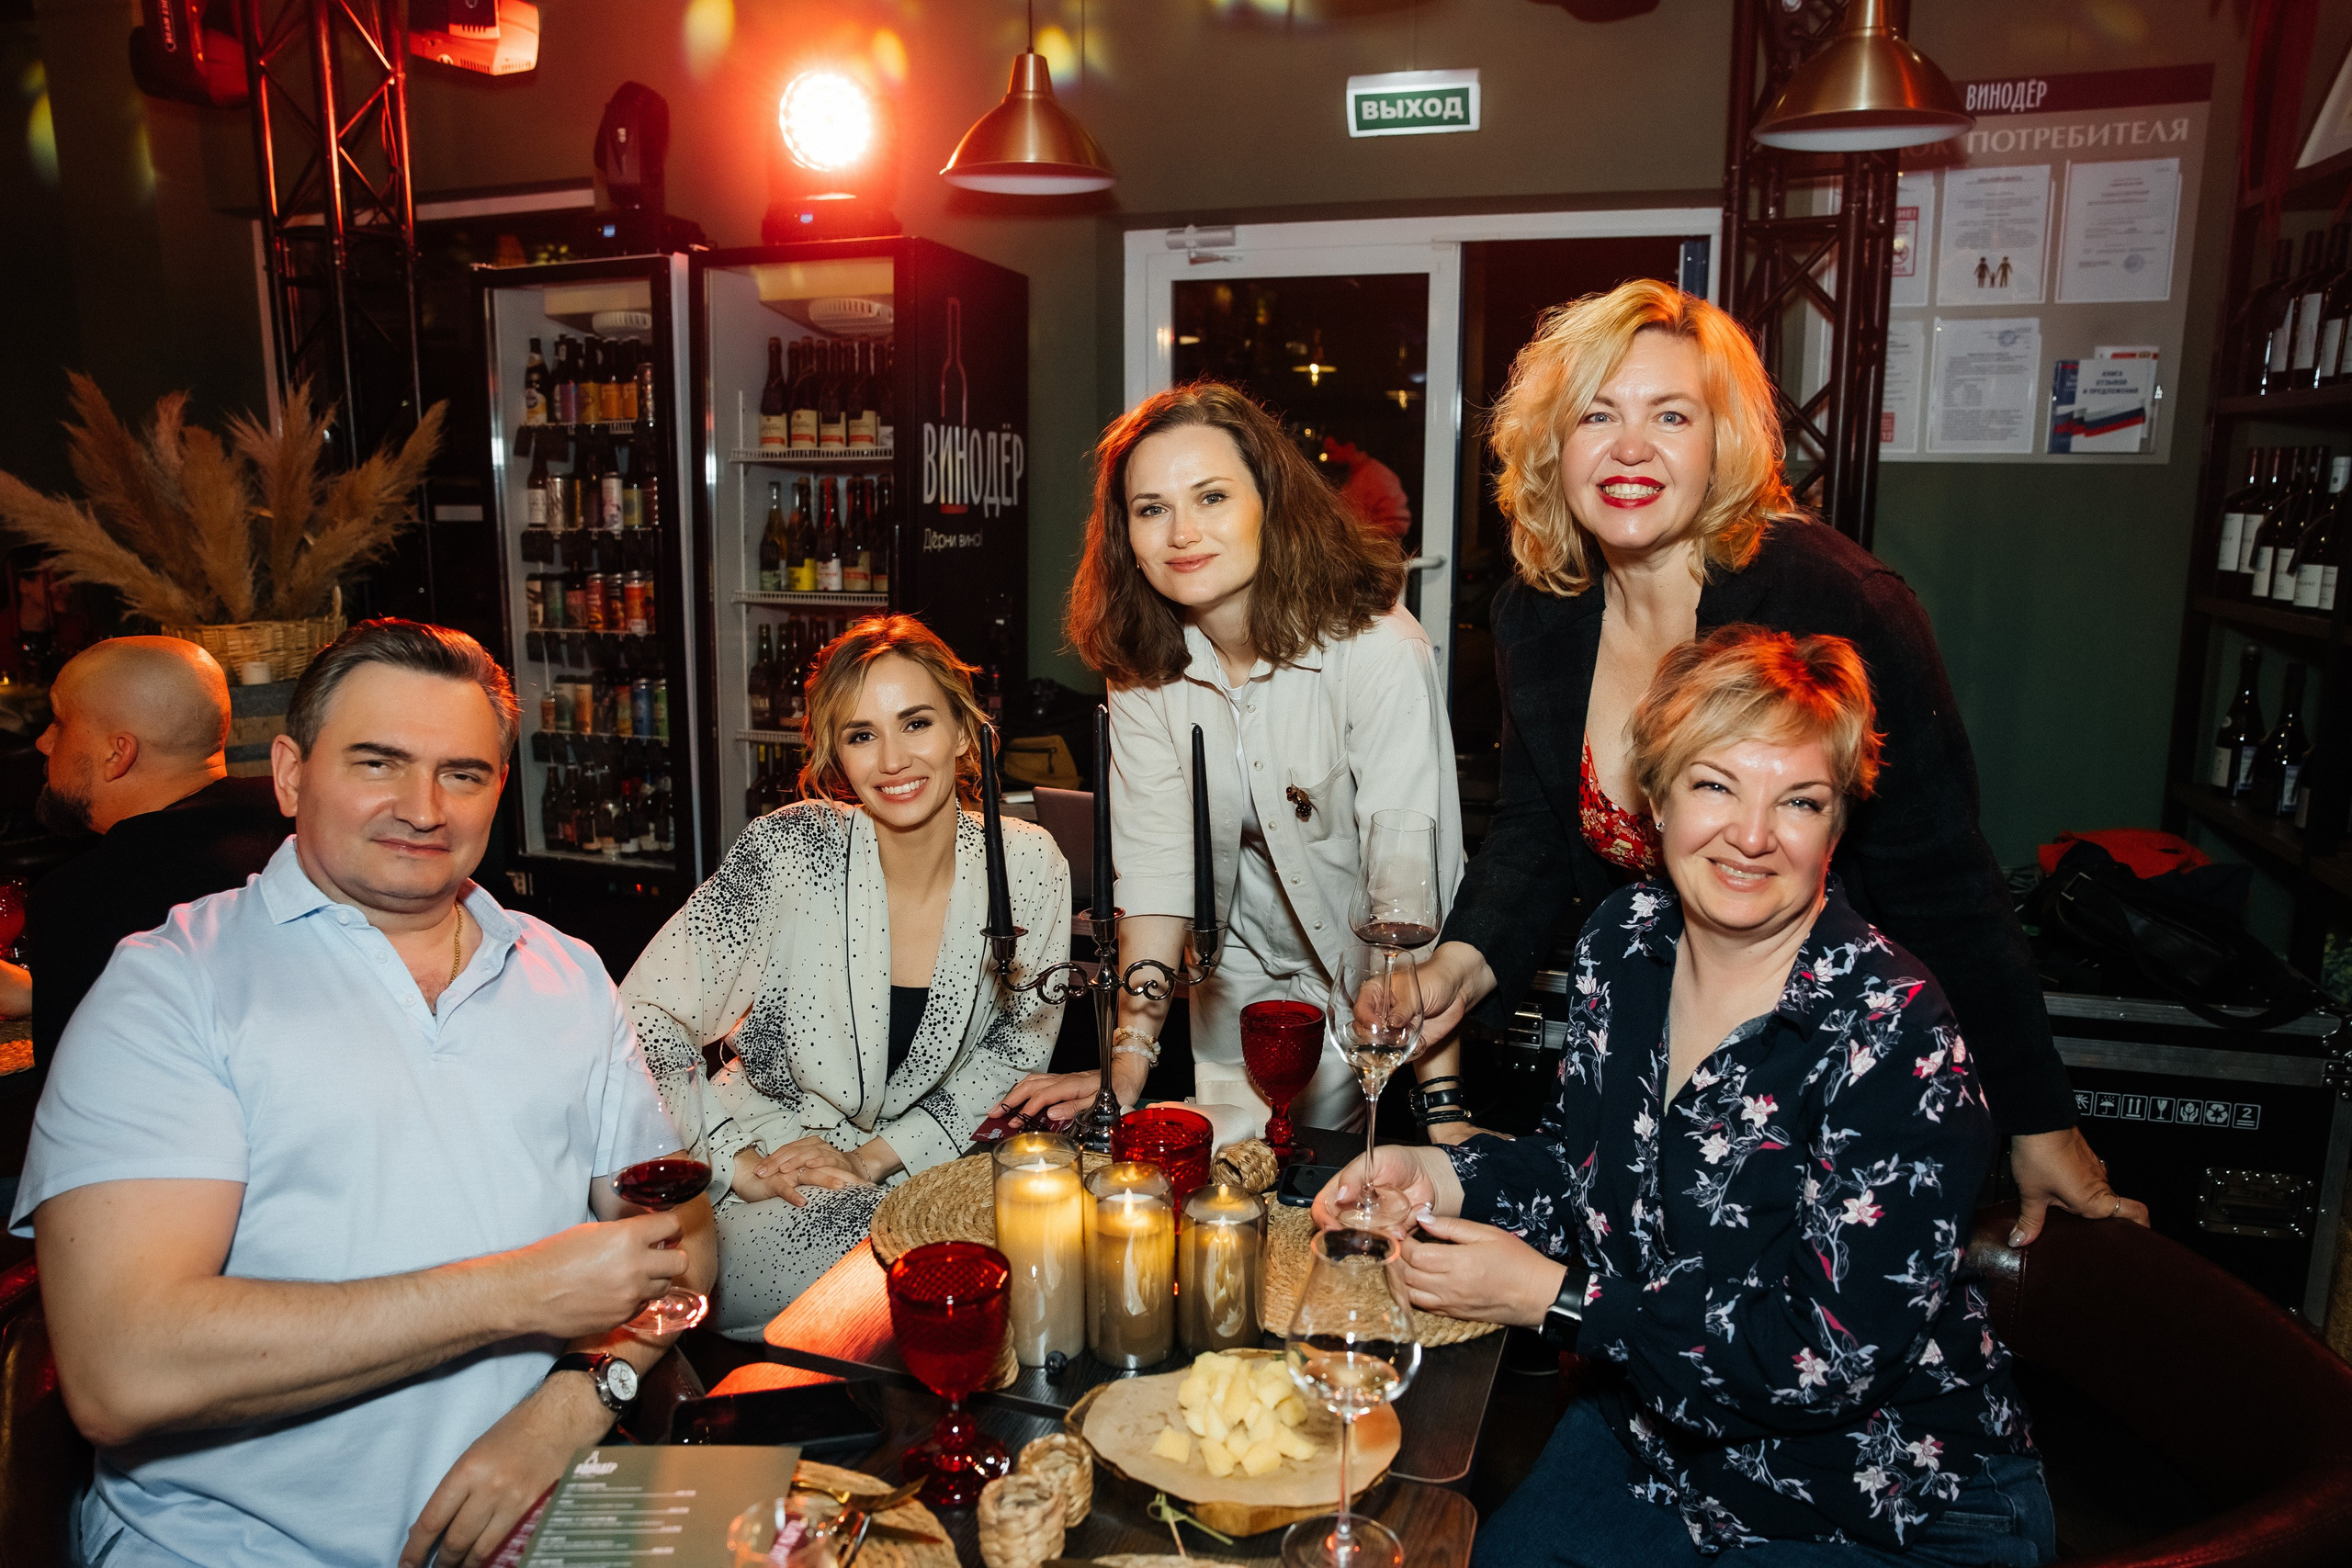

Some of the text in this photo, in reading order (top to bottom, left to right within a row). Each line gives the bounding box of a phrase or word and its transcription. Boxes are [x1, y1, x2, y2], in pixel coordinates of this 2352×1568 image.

[1362, 96, 1464, 120] ВЫХОД
[1965, 78, 2048, 113] ВИНОДЁР
[1967, 118, 2189, 153] ПОТРЕБИТЕЛЯ
[922, 423, 1024, 518] ВИНОДЁР
